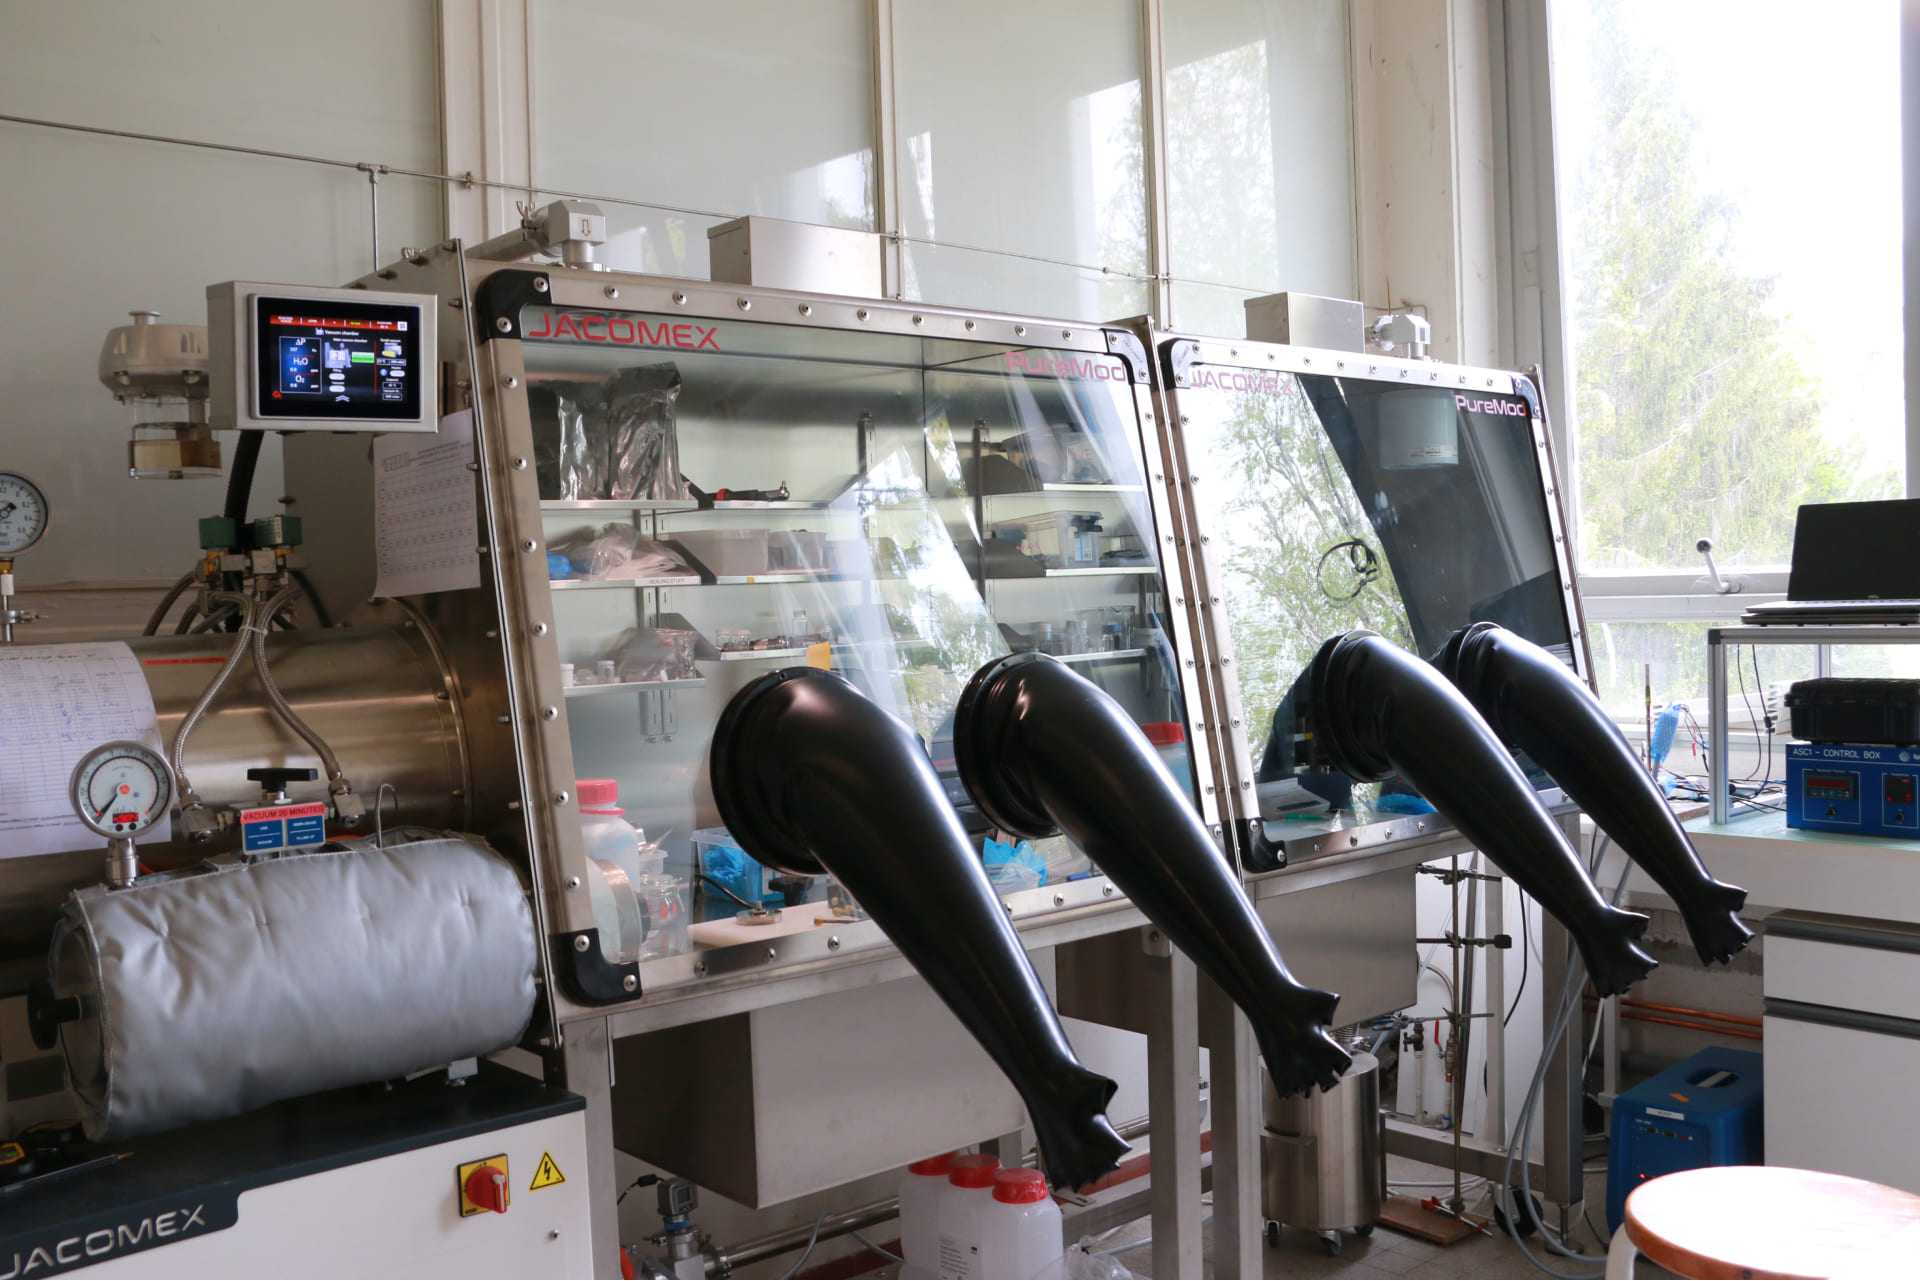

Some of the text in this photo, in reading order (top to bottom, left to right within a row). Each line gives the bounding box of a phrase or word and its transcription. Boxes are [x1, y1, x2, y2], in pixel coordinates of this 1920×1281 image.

[528, 313, 721, 351] JACOMEX
[1005, 351, 1127, 382] PureMod
[1191, 369, 1296, 396] JACOMEX
[1455, 394, 1528, 416] PureMod
[1792, 747, 1813, 756] ASC1
[1823, 748, 1860, 759] CONTROL
[1863, 750, 1881, 760] BOX
[243, 805, 324, 820] VACUUM 20 MINUTES
[0, 1204, 206, 1280] JACOMEX
